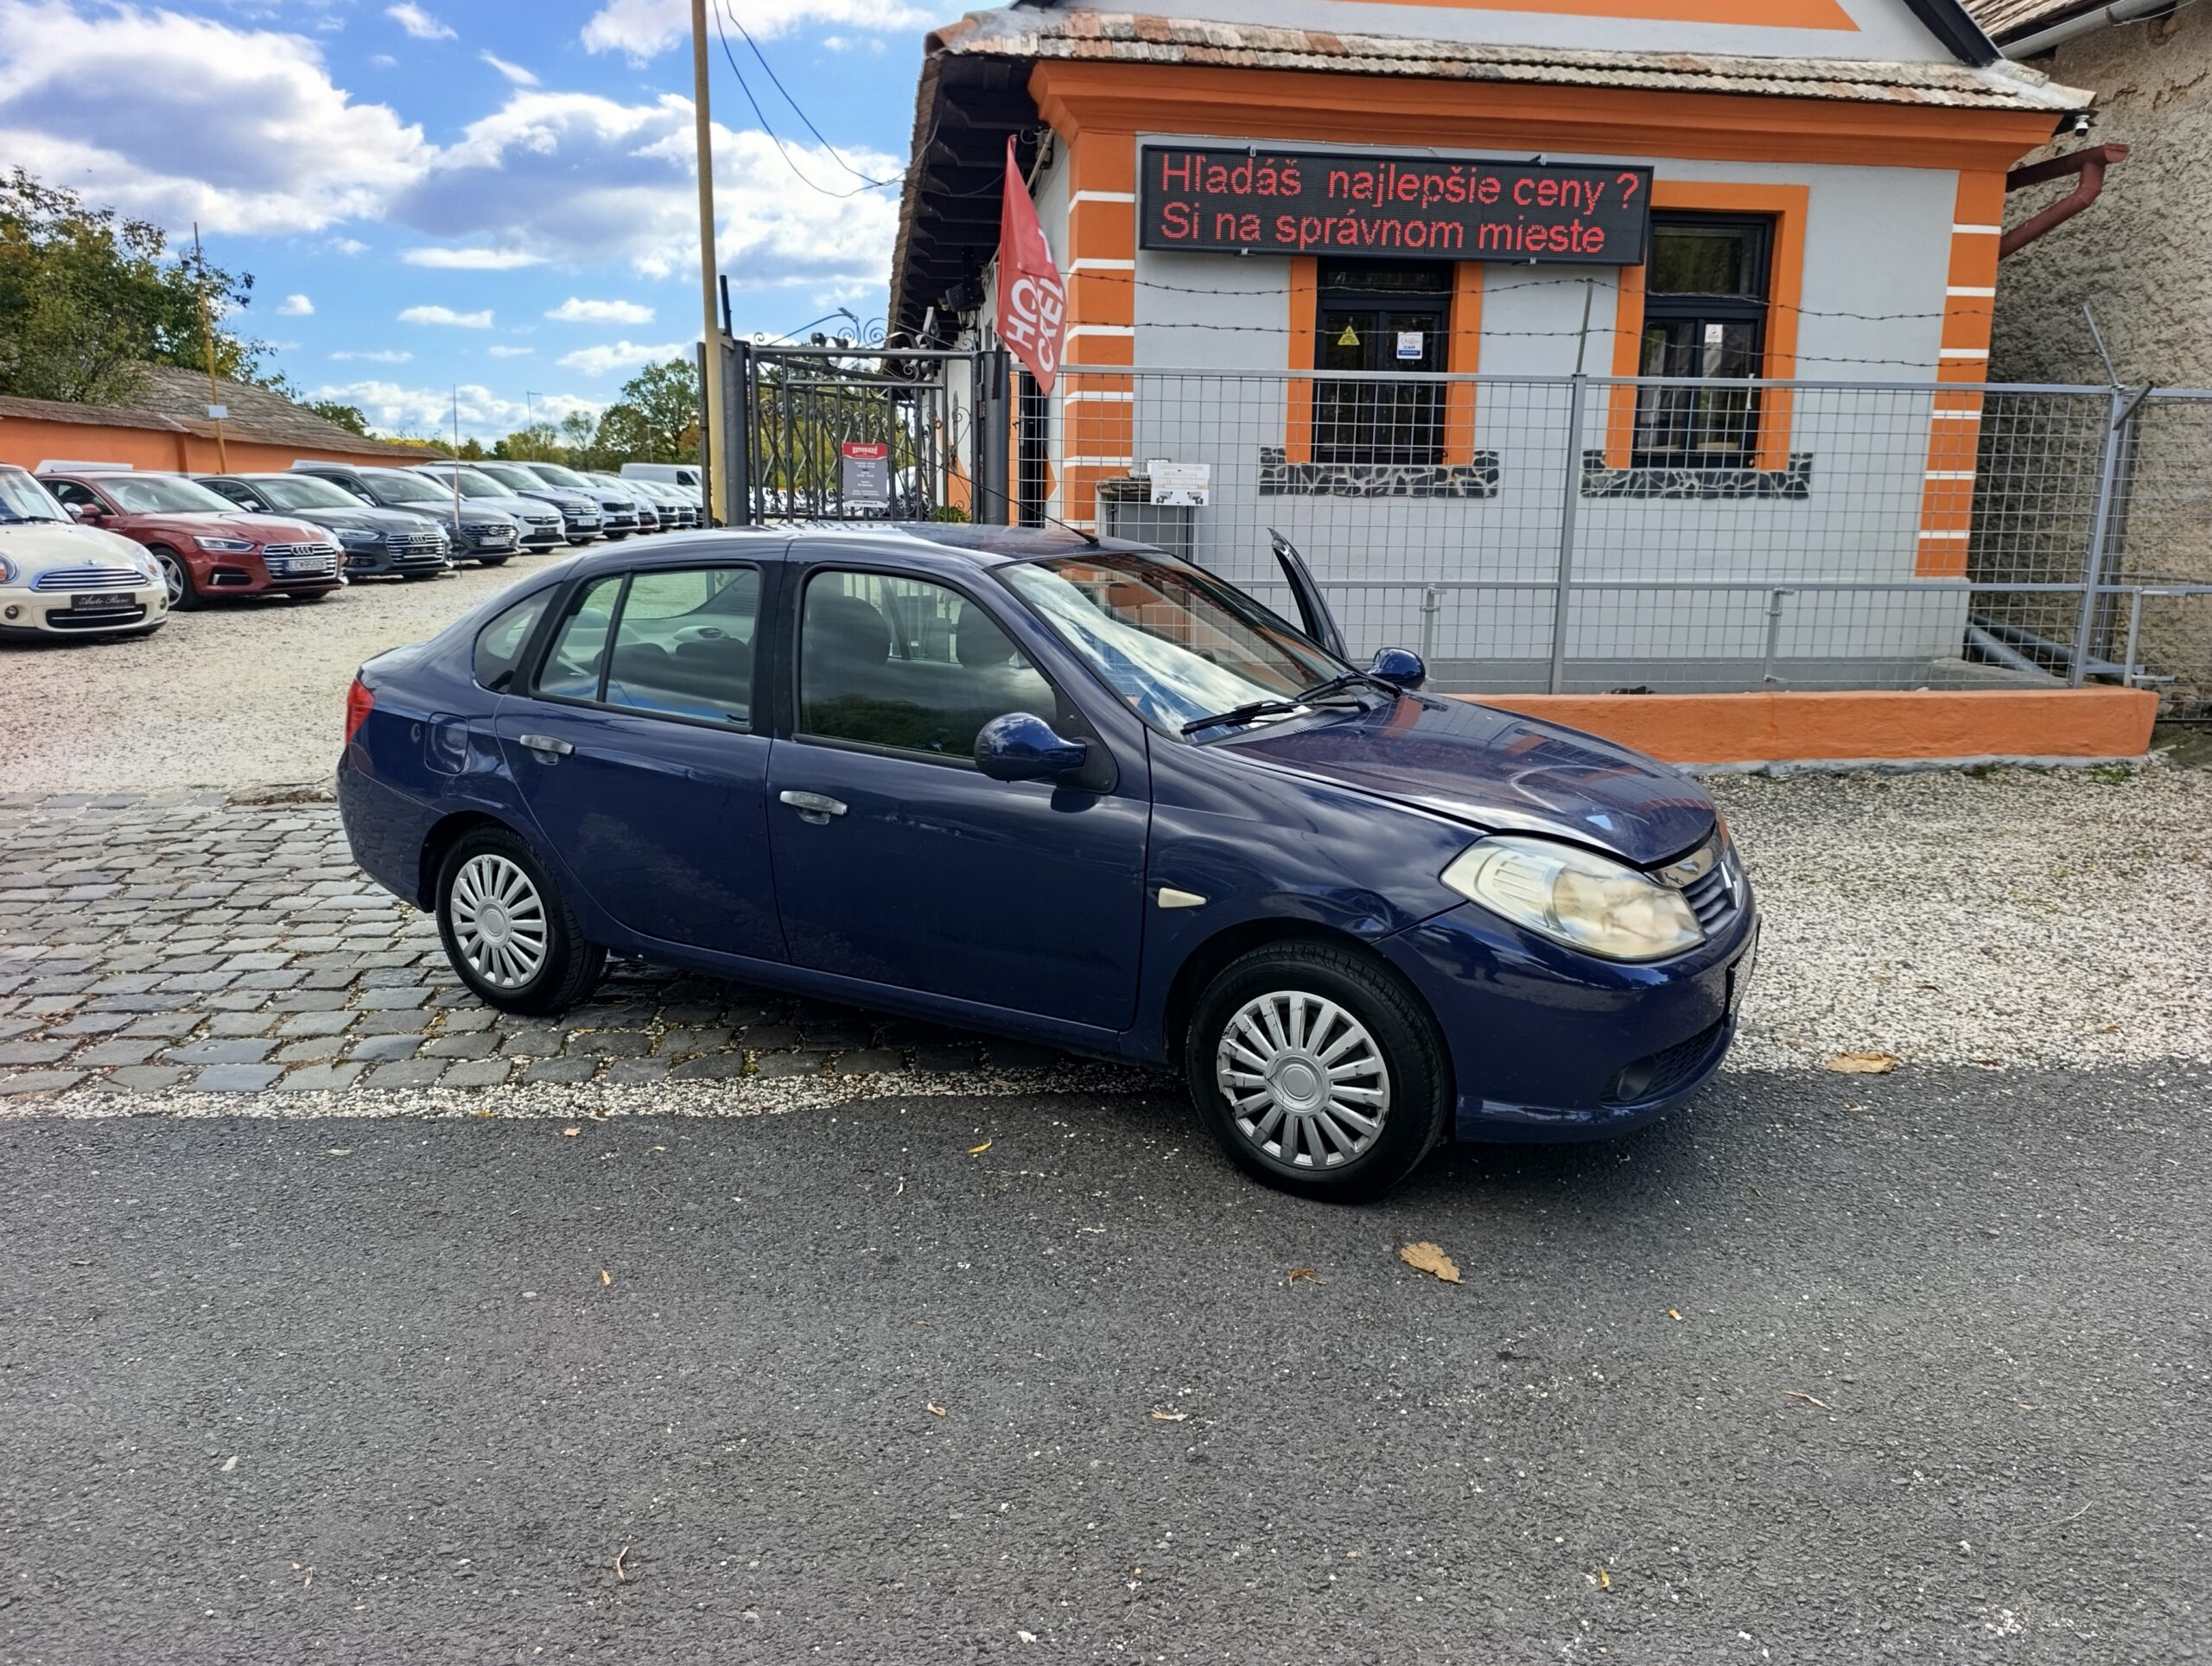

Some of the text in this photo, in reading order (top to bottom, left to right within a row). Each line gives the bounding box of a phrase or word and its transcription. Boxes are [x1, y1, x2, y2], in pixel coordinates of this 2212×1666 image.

[1161, 153, 1639, 215] Hľadáš najlepšie ceny ?
[1161, 200, 1605, 252] Si na správnom mieste
